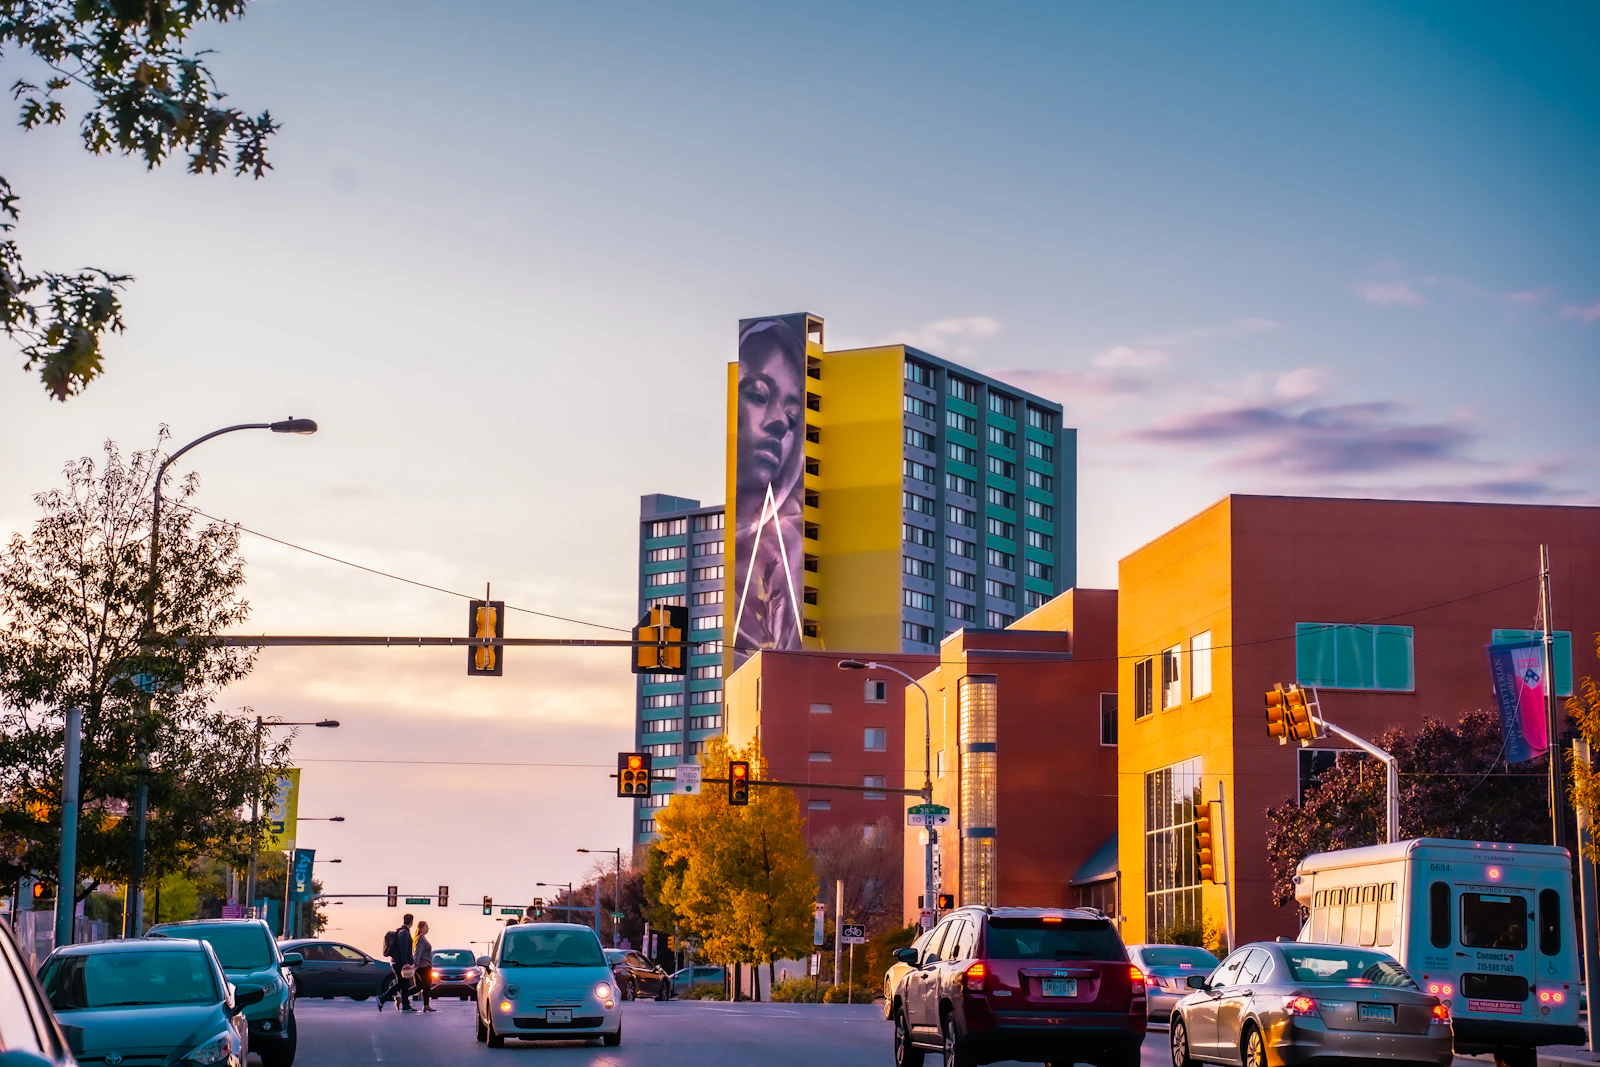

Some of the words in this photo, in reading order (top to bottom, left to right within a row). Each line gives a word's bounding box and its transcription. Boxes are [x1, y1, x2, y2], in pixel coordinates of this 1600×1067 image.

[1494, 659, 1512, 728] PRESBYTERIAN
[1509, 730, 1518, 755] PENN
[1430, 863, 1450, 872] 6634
[295, 853, 311, 893] uCity
[1465, 885, 1502, 893] EMERGENCY
[1476, 951, 1503, 961] Connect
[1477, 963, 1514, 973] 215-580-7145
